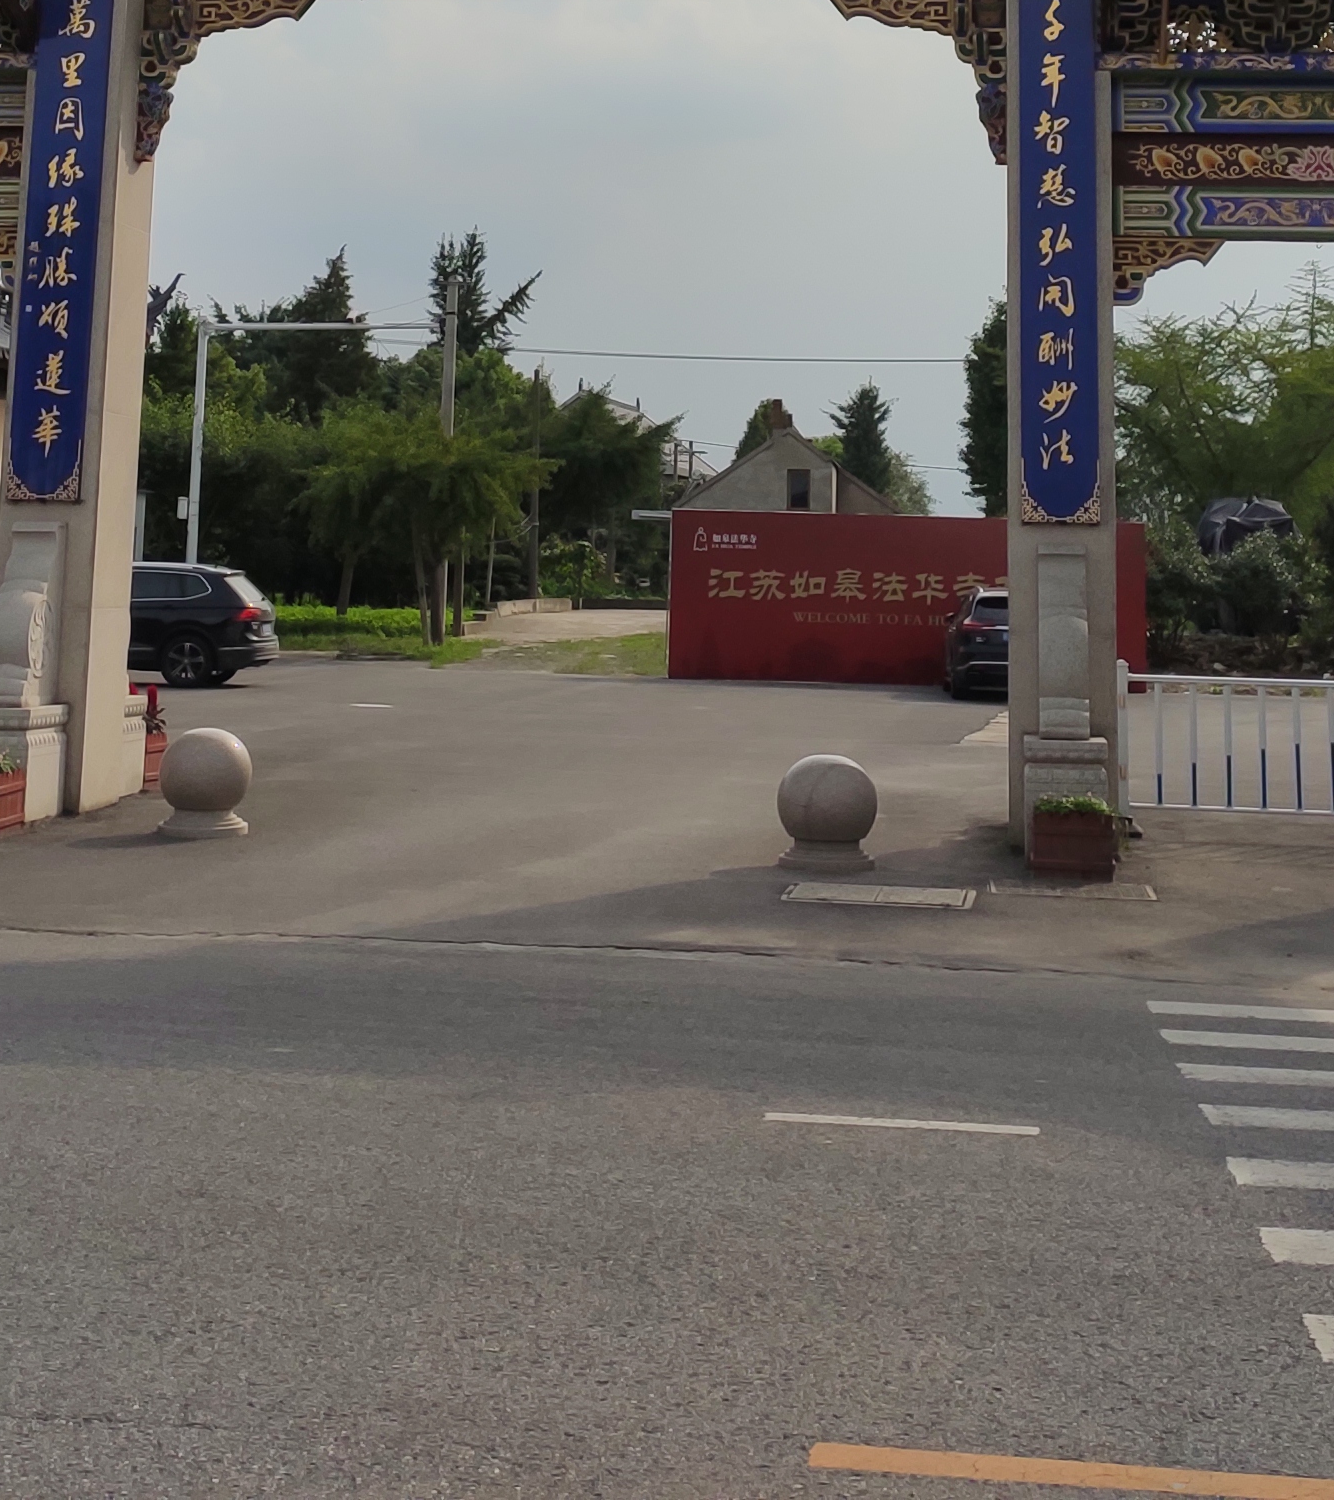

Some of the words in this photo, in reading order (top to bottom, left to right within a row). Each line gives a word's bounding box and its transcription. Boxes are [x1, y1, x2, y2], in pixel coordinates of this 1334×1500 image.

[793, 610, 870, 625] WELCOME
[876, 612, 899, 626] TO
[903, 612, 925, 627] FA
